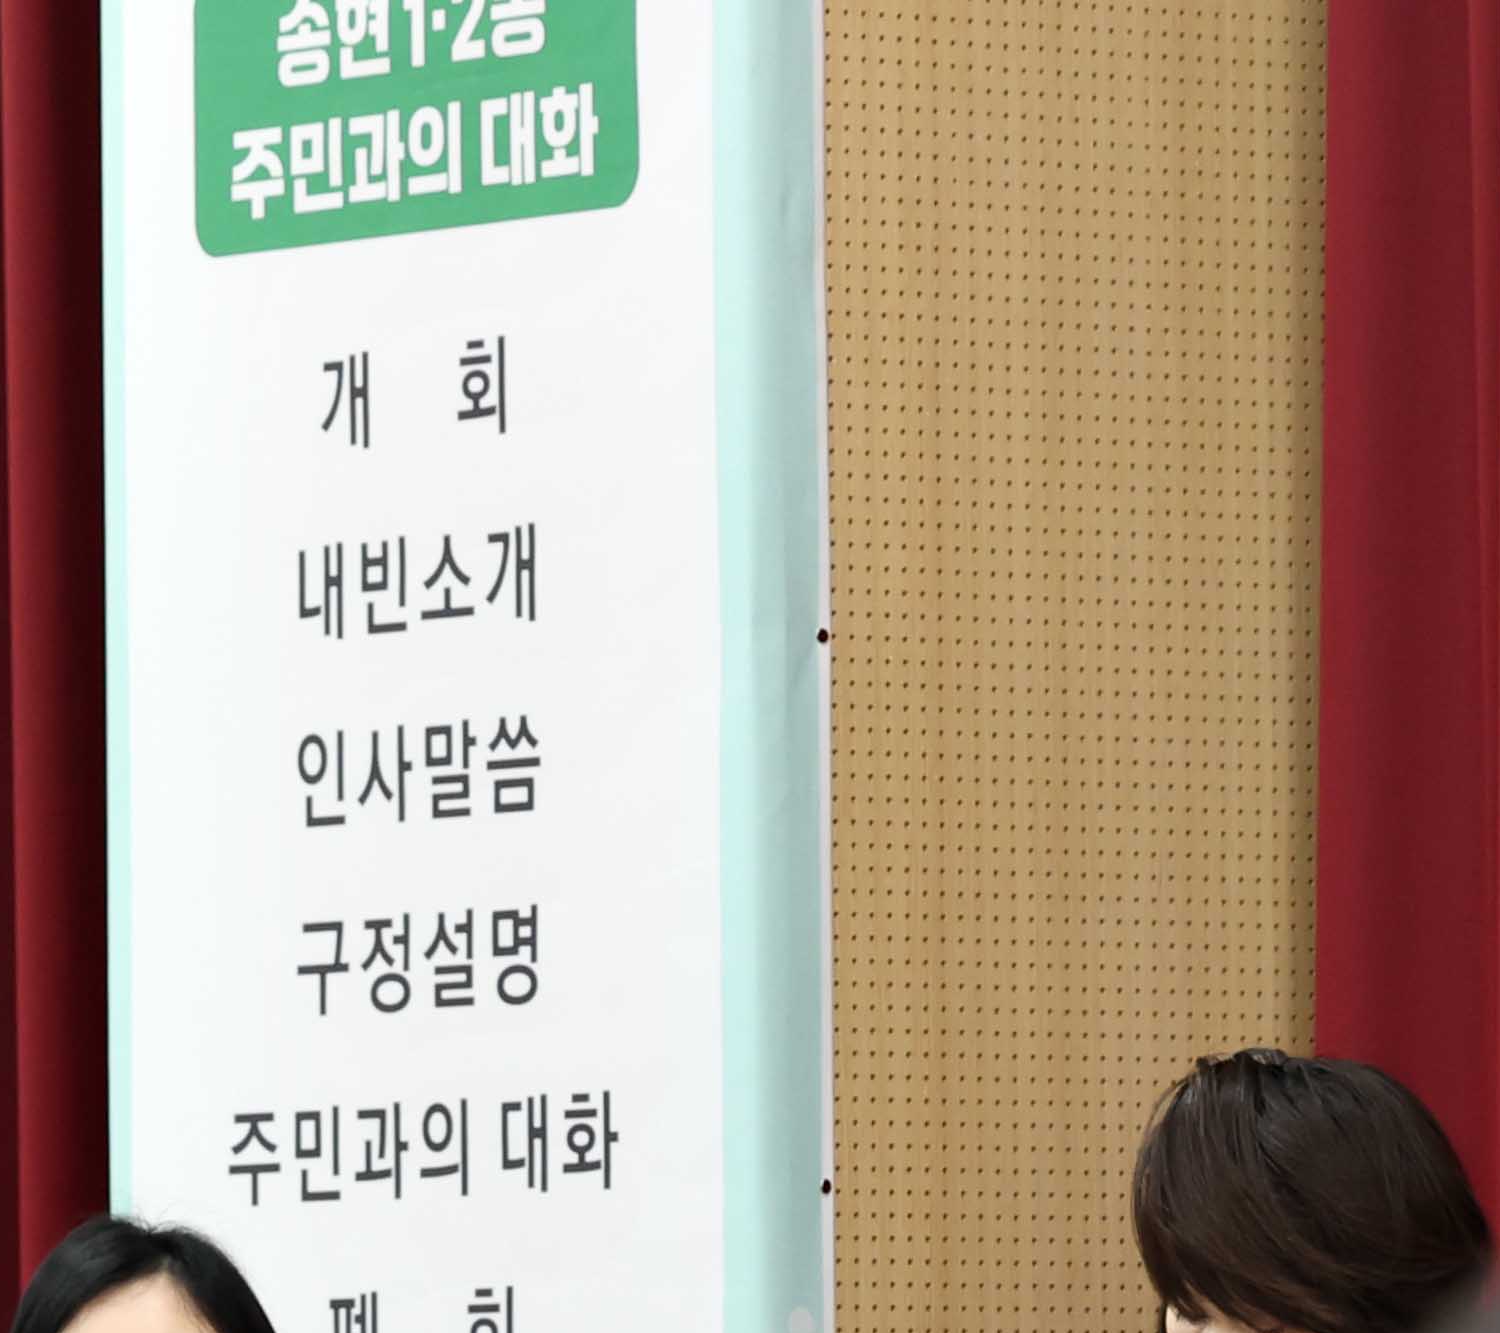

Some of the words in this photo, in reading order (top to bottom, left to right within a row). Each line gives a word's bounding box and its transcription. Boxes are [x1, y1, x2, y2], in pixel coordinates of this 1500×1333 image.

[230, 100, 463, 220] 주민과의
[480, 82, 600, 186] 대화
[298, 522, 537, 640] 내빈소개
[297, 714, 542, 828] 인사말씀
[297, 903, 540, 1016] 구정설명
[228, 1097, 470, 1206] 주민과의
[500, 1089, 620, 1193] 대화
